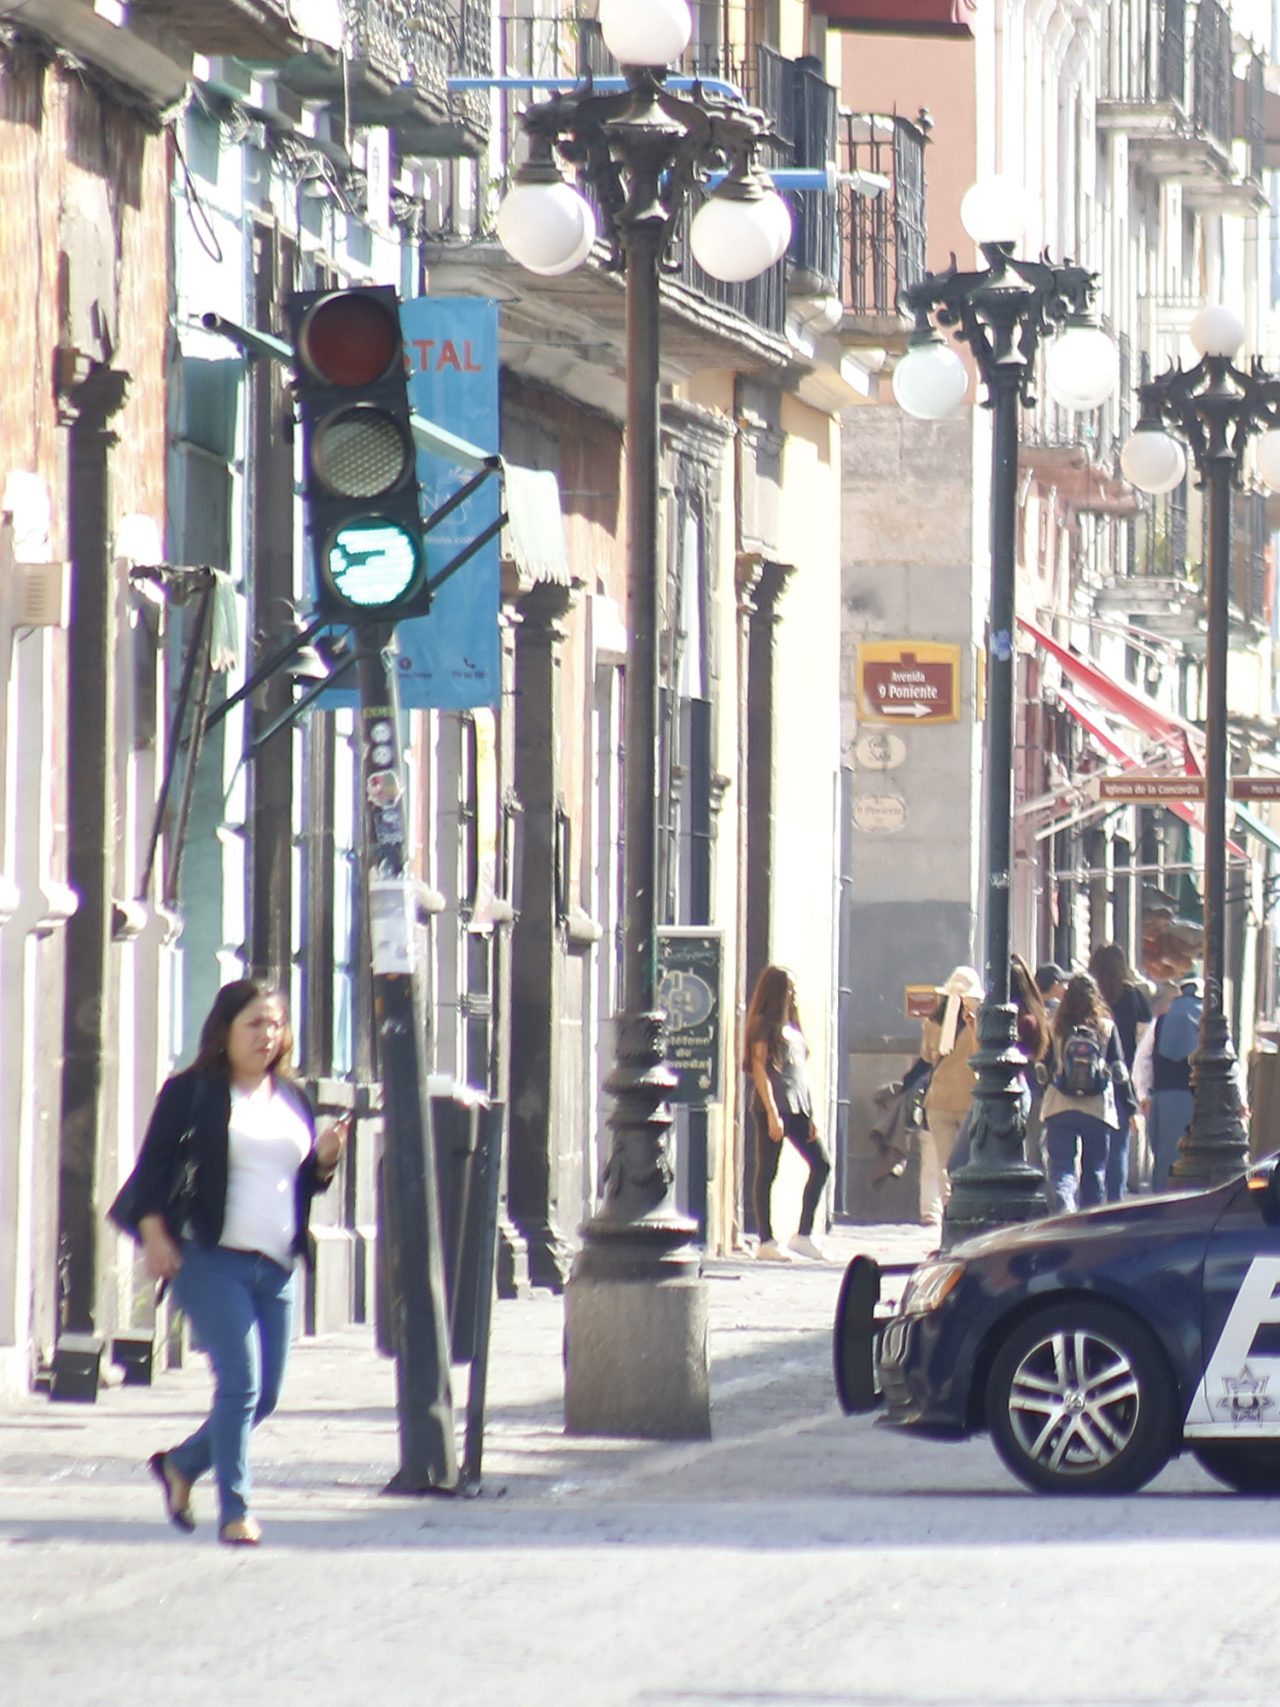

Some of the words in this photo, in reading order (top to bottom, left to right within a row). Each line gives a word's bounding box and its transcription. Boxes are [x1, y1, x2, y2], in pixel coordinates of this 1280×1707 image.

[891, 670, 925, 682] Avenida
[878, 684, 886, 698] 9
[889, 684, 938, 699] Poniente
[1105, 784, 1133, 796] Iglesia
[1134, 784, 1146, 794] de
[1147, 784, 1157, 794] la
[1158, 784, 1199, 795] Concordia
